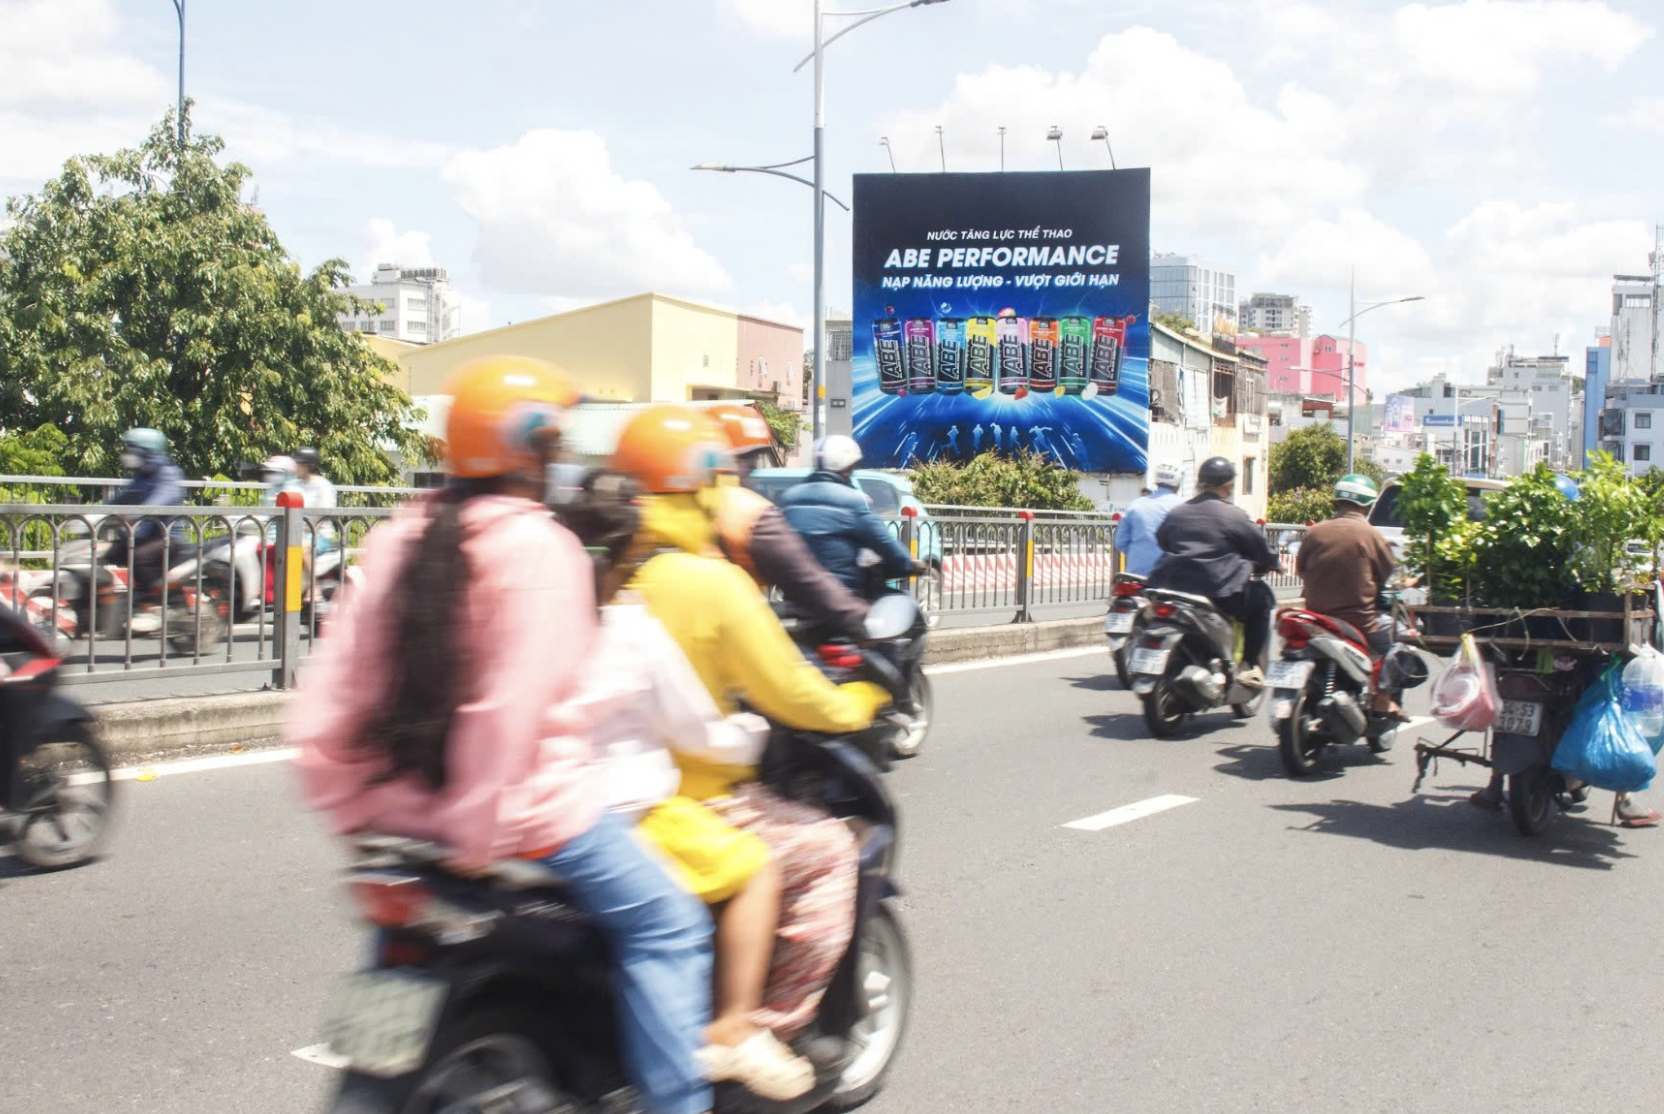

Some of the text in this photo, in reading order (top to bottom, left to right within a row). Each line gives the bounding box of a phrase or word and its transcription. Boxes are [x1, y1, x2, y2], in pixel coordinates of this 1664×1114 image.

[927, 225, 1073, 242] NƯỚC TĂNG LỰC THỂ THAO
[884, 245, 1120, 268] ABE PERFORMANCE
[882, 276, 910, 291] NẠP
[912, 273, 953, 288] NĂNG
[956, 274, 1003, 291] LƯỢNG
[1015, 274, 1051, 291] VƯỢT
[1054, 271, 1085, 287] GIỚI
[1088, 273, 1120, 289] HẠN
[879, 338, 901, 379] ABE
[911, 334, 929, 375] ABE
[940, 338, 958, 380] ABE
[969, 334, 988, 376] ABE
[1003, 333, 1021, 375] ABE
[1033, 337, 1050, 378] ABE
[1063, 333, 1081, 375] ABE
[1094, 333, 1113, 379] ABE
